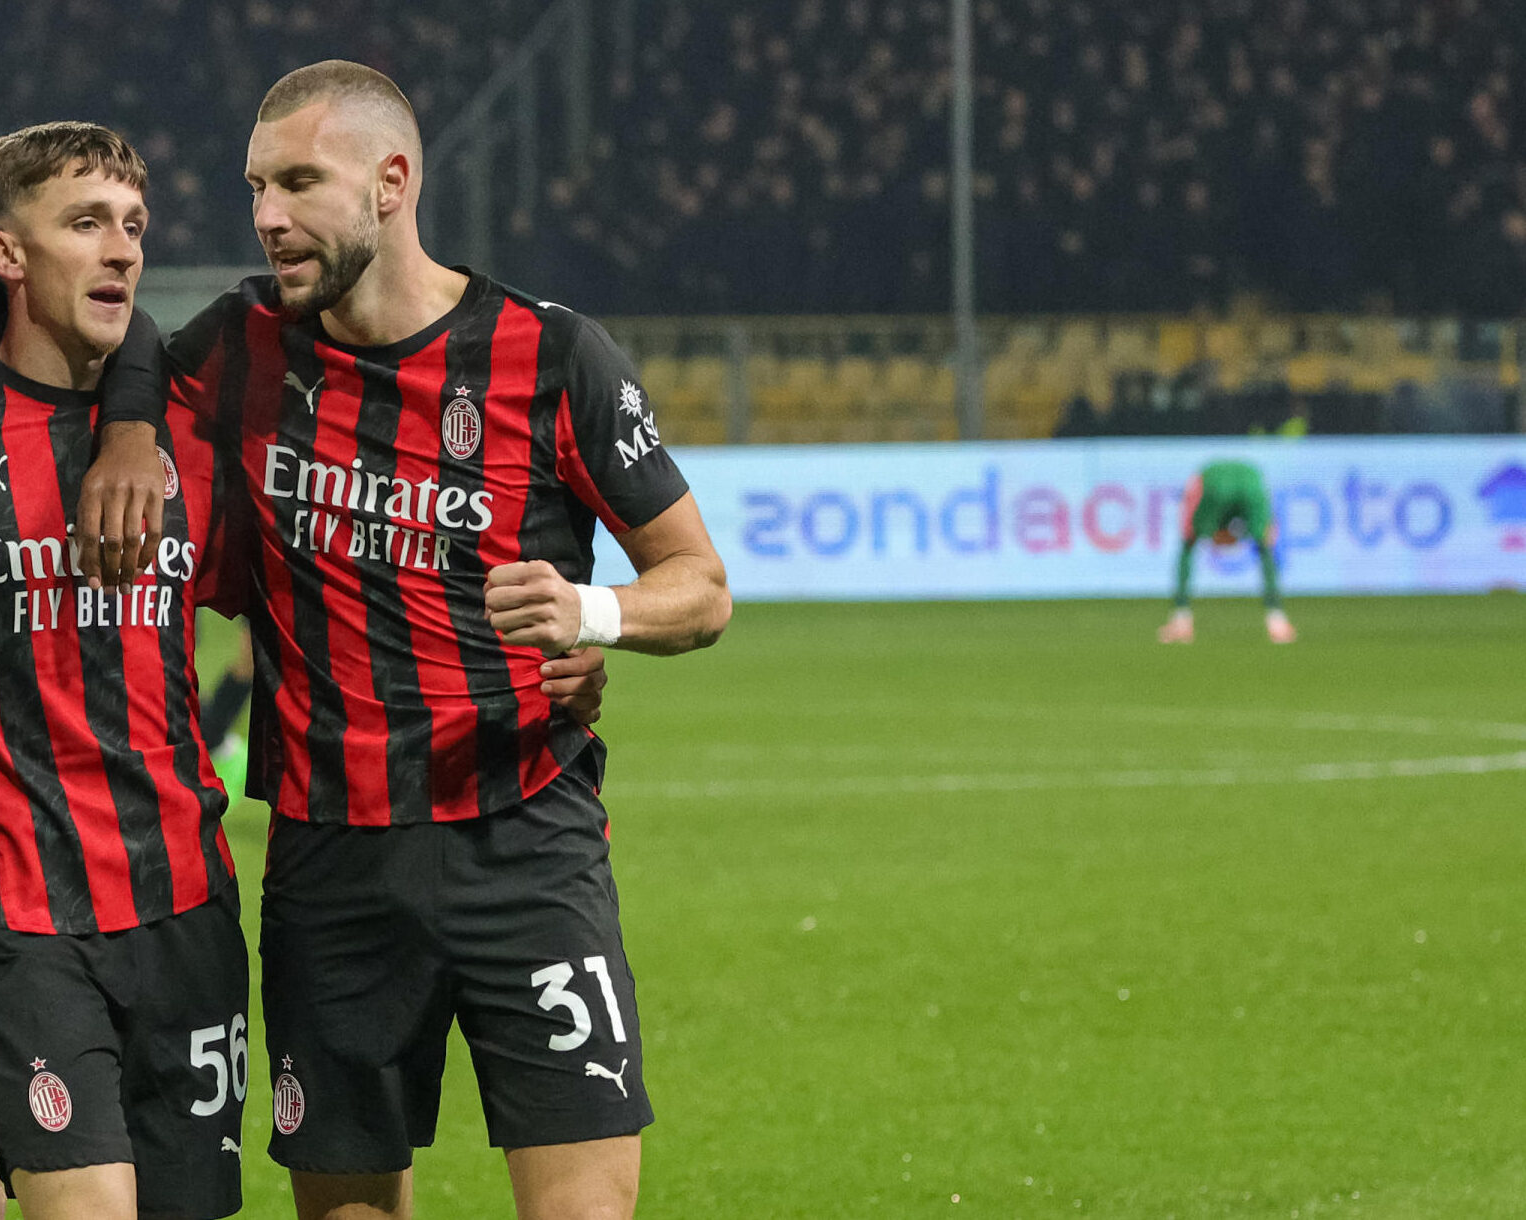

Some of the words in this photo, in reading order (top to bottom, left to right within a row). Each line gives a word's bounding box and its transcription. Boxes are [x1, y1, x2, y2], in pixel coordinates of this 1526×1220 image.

[263, 443, 494, 532] Emirates
[739, 463, 1453, 577] zondacrpto
[292, 509, 341, 553] FLY
[347, 518, 451, 571] BETTER
[13, 587, 63, 633] FLY
[531, 955, 627, 1052] 31
[190, 1012, 249, 1117] 56
